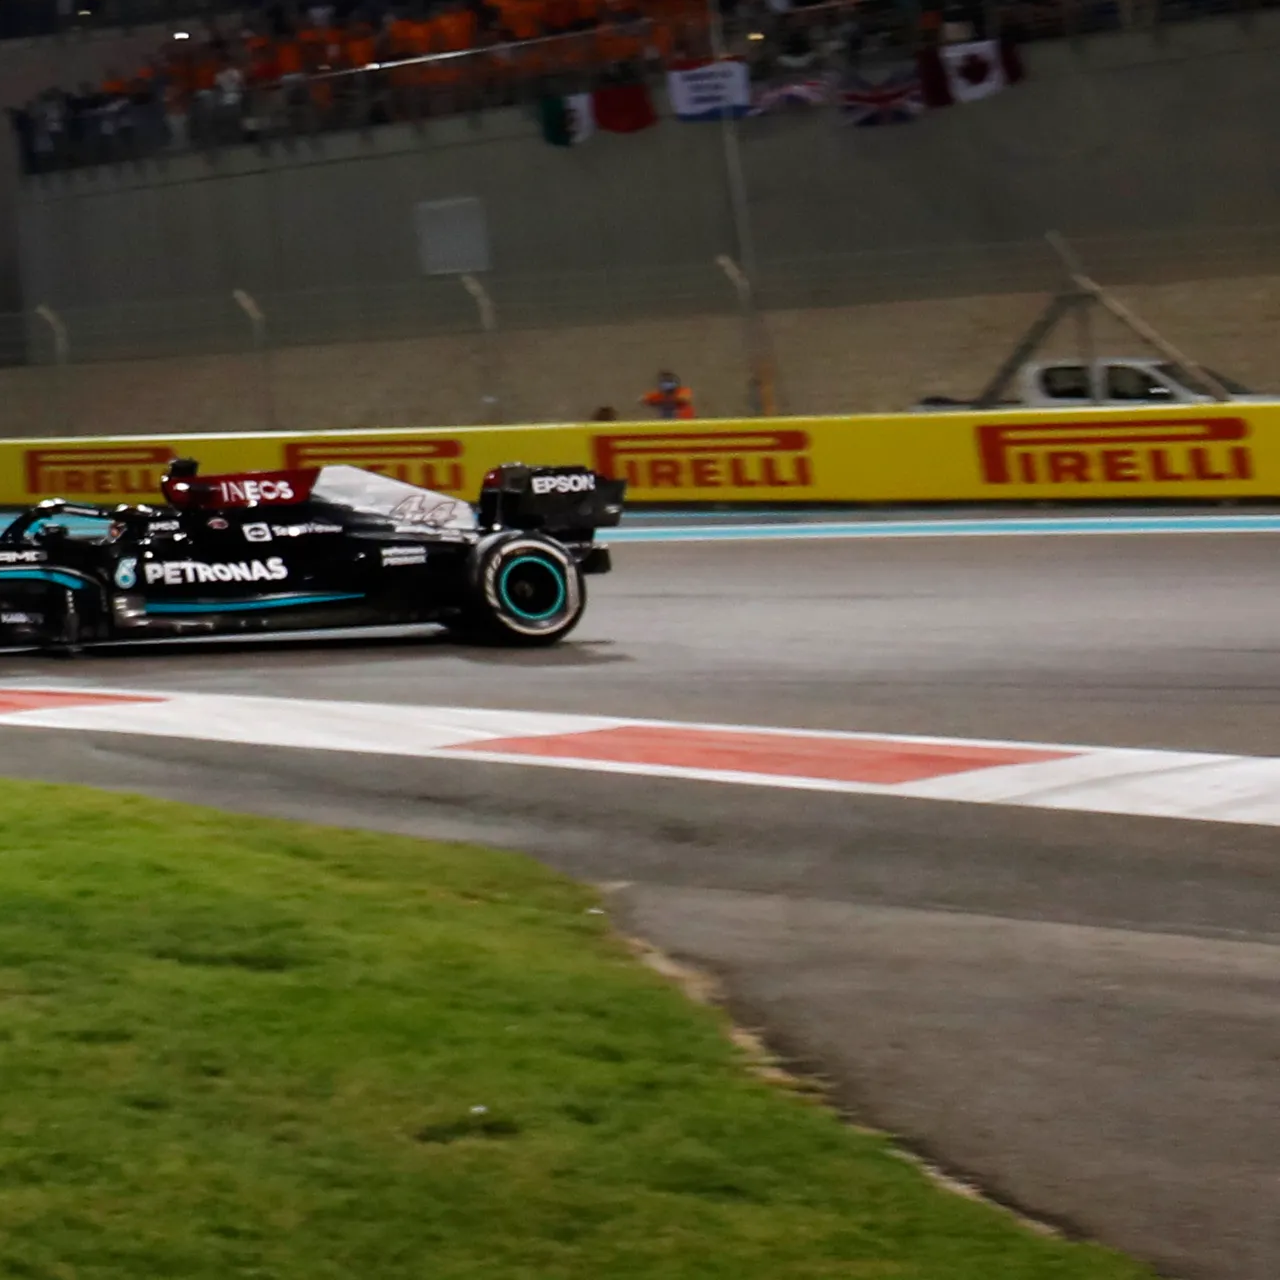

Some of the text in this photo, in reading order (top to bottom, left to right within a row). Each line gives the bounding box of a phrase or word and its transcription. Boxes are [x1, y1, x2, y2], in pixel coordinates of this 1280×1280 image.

[25, 446, 177, 494] PIRELL
[284, 440, 464, 491] PLLI
[592, 430, 811, 488] PIRELLI
[974, 416, 1251, 485] PIRELLI
[220, 480, 294, 502] INEOS
[532, 474, 595, 494] EPSON
[390, 494, 458, 527] 44
[144, 557, 289, 585] PETRONAS
